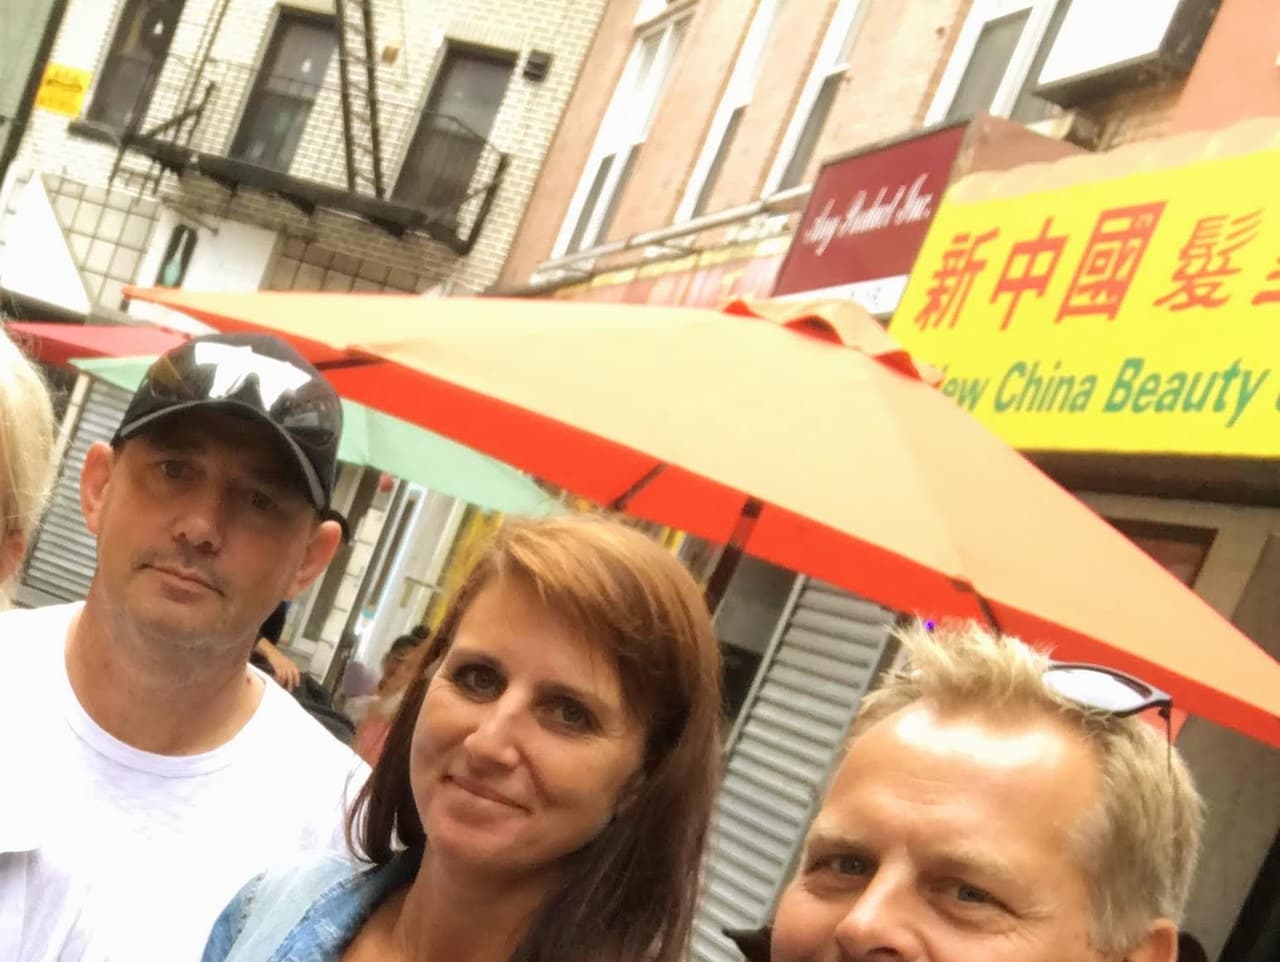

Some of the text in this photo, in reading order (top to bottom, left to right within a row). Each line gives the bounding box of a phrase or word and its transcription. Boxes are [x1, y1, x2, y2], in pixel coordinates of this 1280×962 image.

[930, 357, 1271, 428] ew China Beauty
